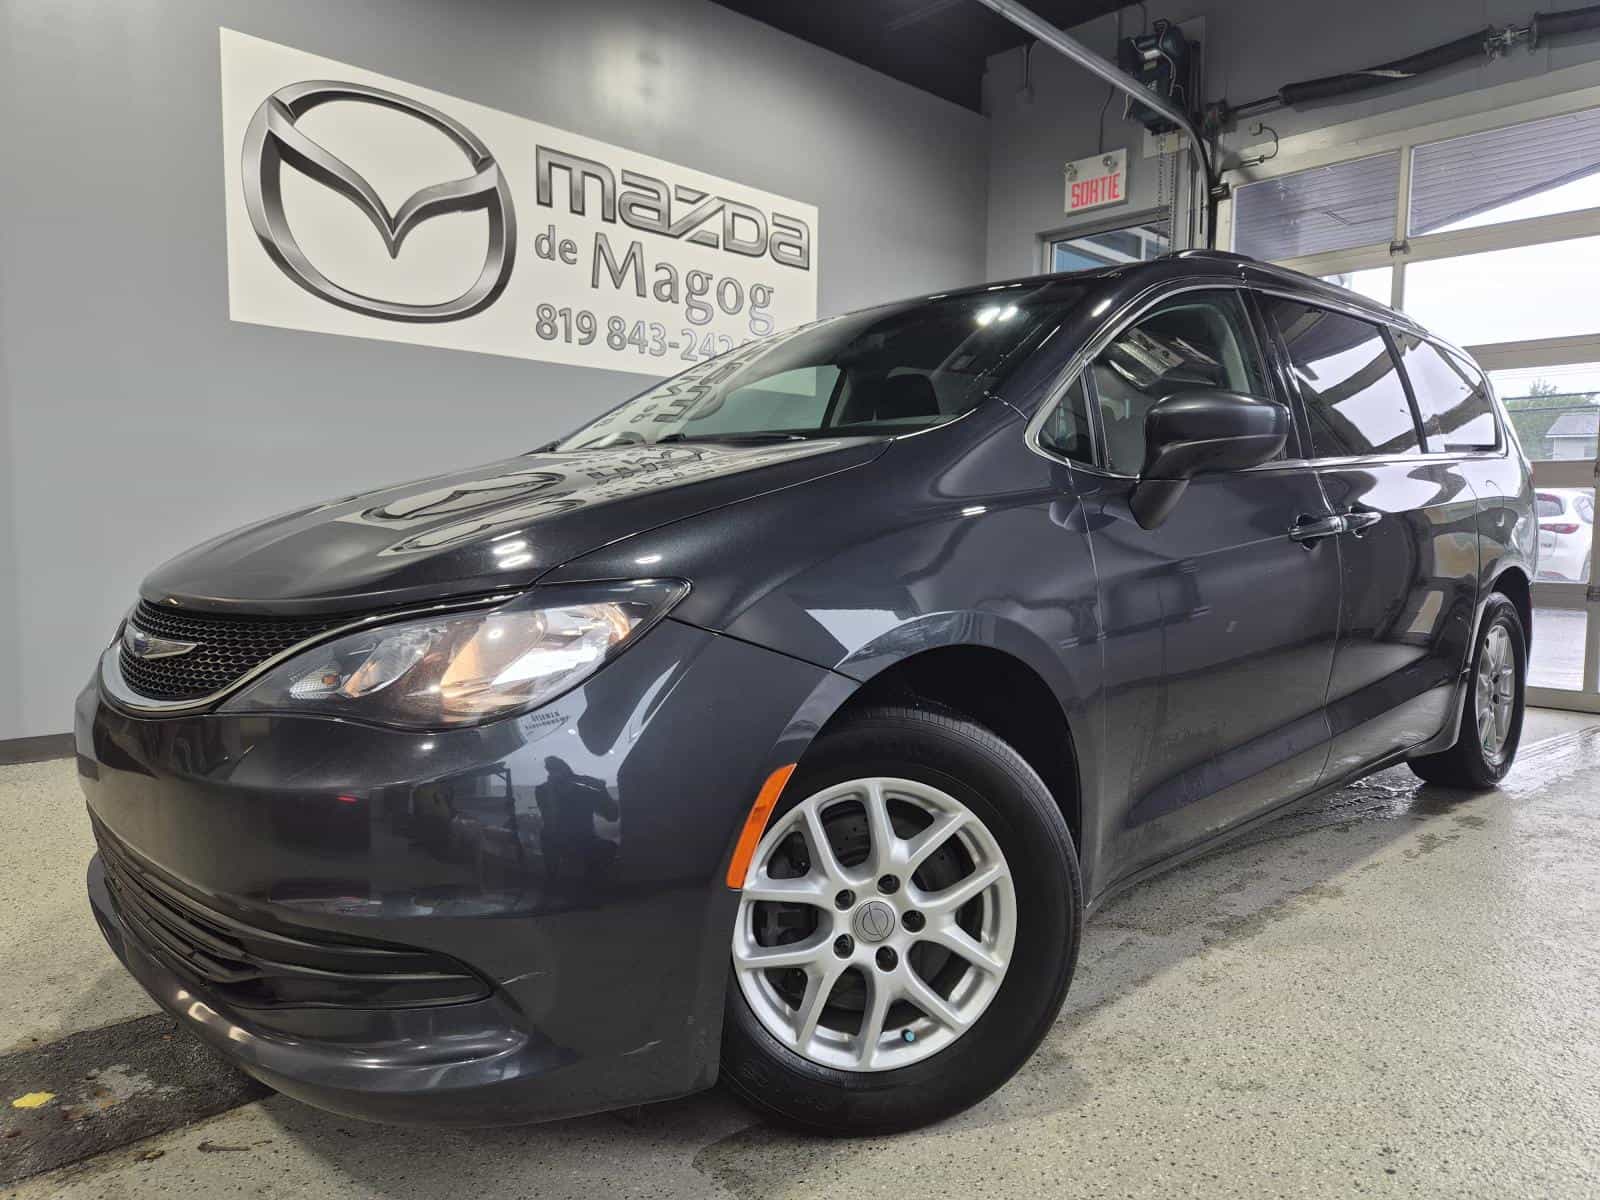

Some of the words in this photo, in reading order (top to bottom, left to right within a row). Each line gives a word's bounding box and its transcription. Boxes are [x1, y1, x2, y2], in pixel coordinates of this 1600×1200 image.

[1071, 173, 1121, 209] SORTIE
[534, 224, 578, 265] de
[590, 231, 775, 337] Magog
[535, 303, 598, 346] 819
